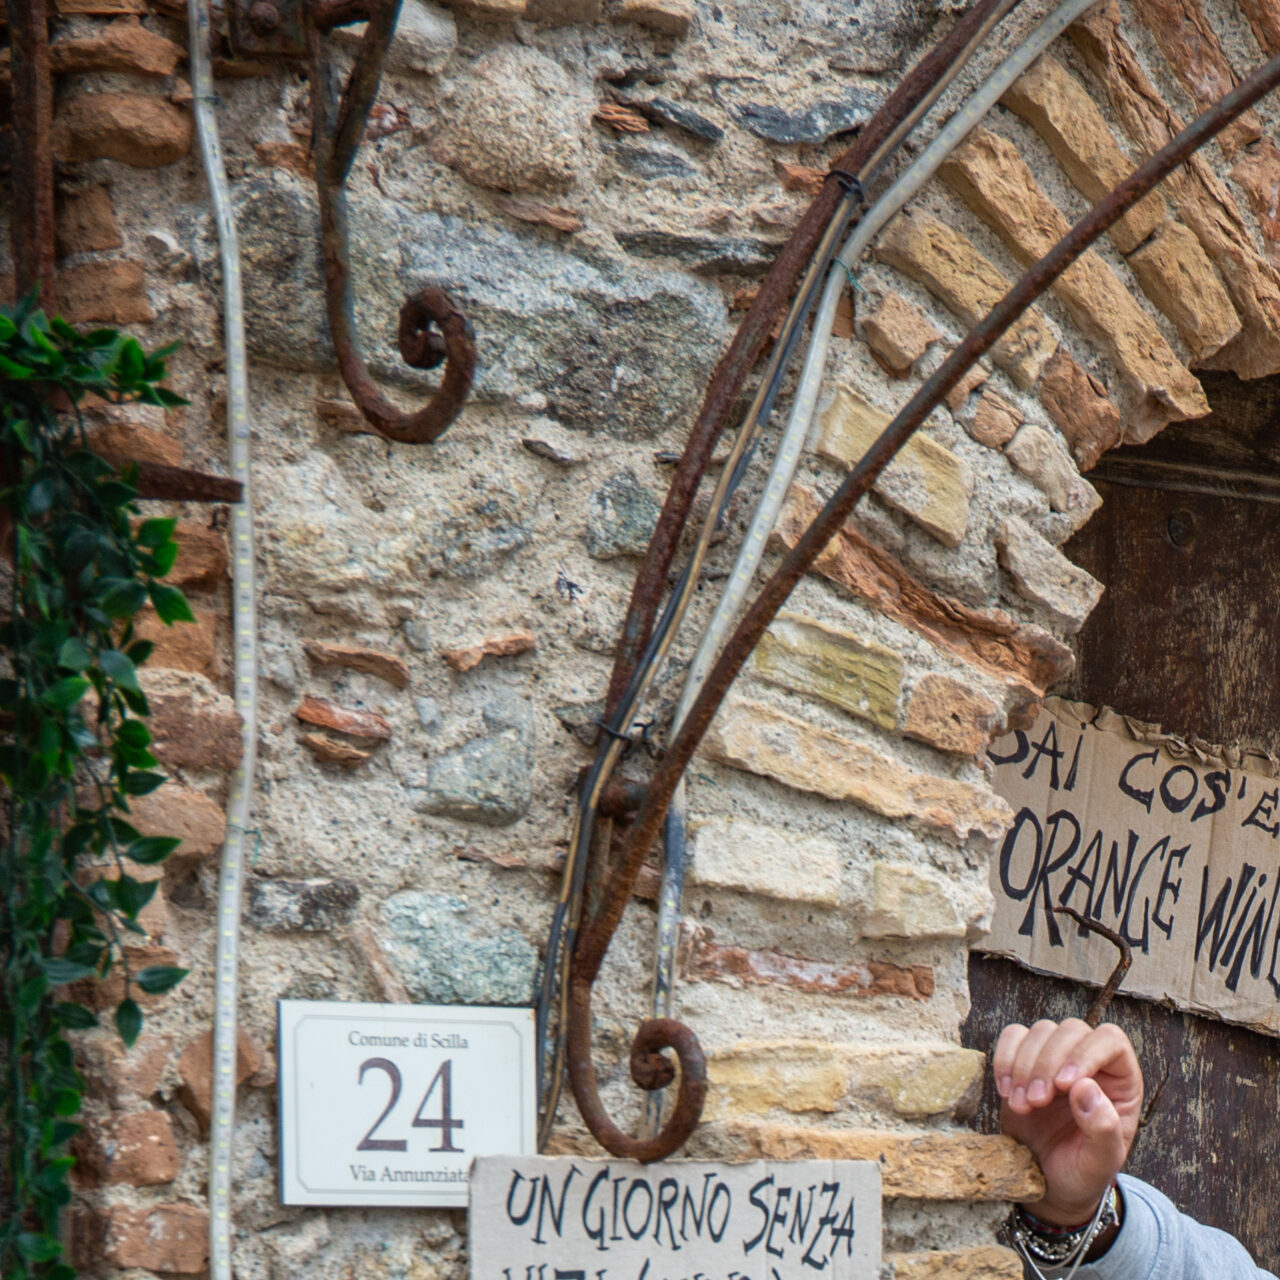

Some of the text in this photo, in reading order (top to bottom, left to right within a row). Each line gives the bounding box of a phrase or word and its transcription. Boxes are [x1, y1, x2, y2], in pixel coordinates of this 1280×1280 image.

[1000, 806, 1192, 955] ORANGE
[347, 1030, 469, 1049] Comune di Scilla
[356, 1056, 465, 1153] 24
[349, 1164, 376, 1181] Via
[506, 1164, 856, 1270] UN GIORNO SENZA
